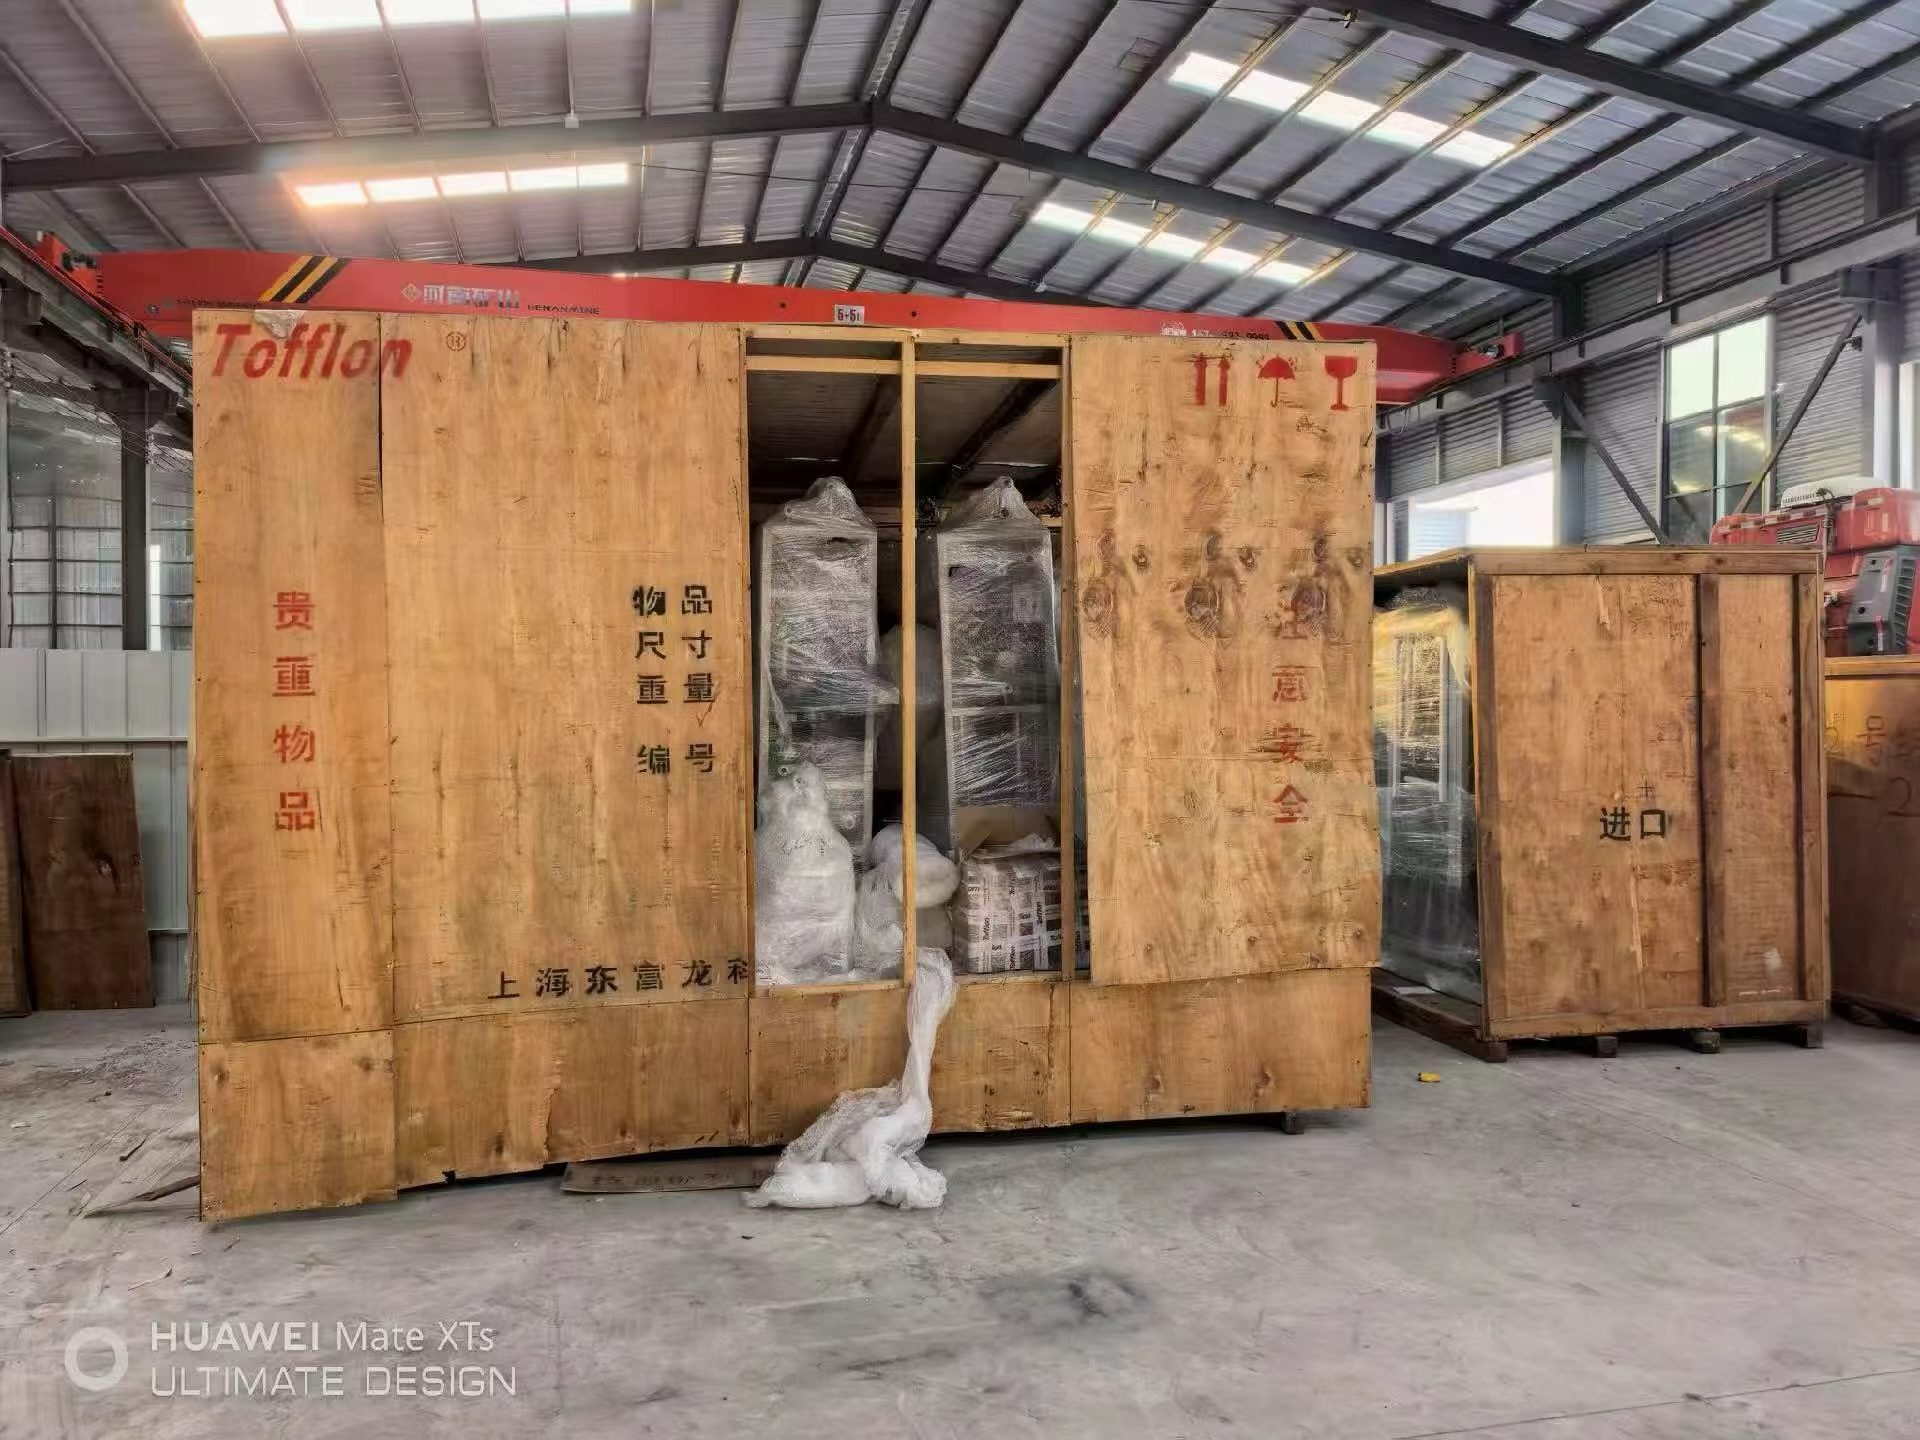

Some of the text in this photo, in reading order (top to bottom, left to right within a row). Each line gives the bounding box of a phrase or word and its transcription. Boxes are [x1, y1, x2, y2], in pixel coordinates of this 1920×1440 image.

[212, 322, 412, 378] Tofflon
[632, 584, 713, 618] 物品
[635, 629, 713, 660] 尺寸
[636, 672, 716, 705] 重量
[272, 590, 316, 832] 贵重物品
[637, 743, 716, 776] 编号
[1599, 806, 1667, 841] 进口
[982, 917, 991, 943] Tofflon
